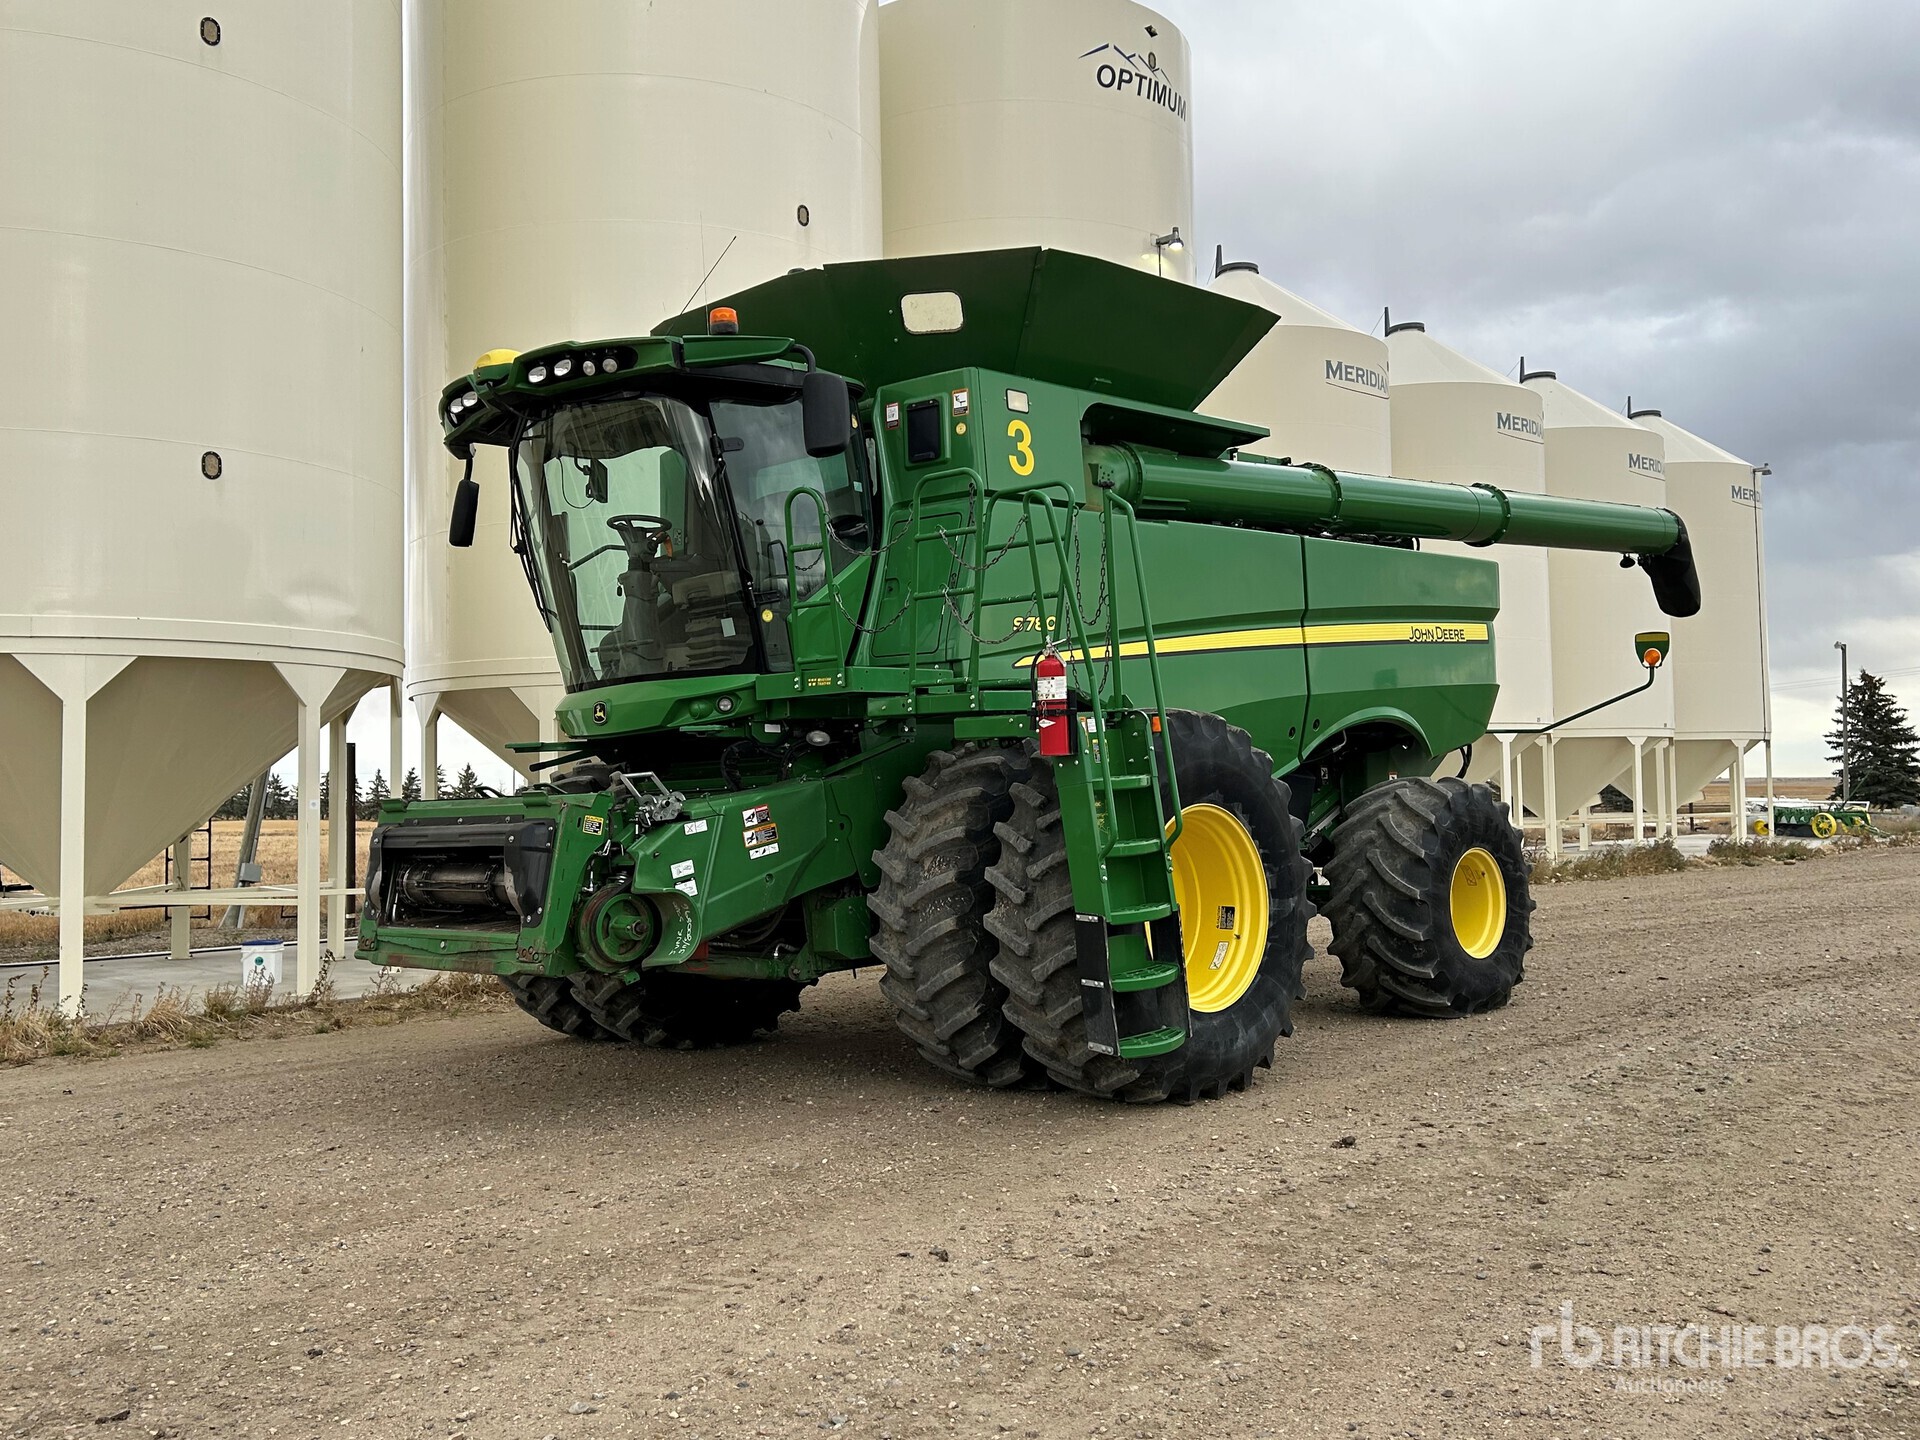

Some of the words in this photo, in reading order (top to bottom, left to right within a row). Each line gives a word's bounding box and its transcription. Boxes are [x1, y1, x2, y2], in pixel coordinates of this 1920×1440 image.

[1096, 64, 1187, 122] OPTIMUM
[1007, 419, 1035, 476] 3
[1013, 615, 1057, 632] S780
[1409, 626, 1434, 641] JOHN
[1435, 626, 1466, 641] DEERE
